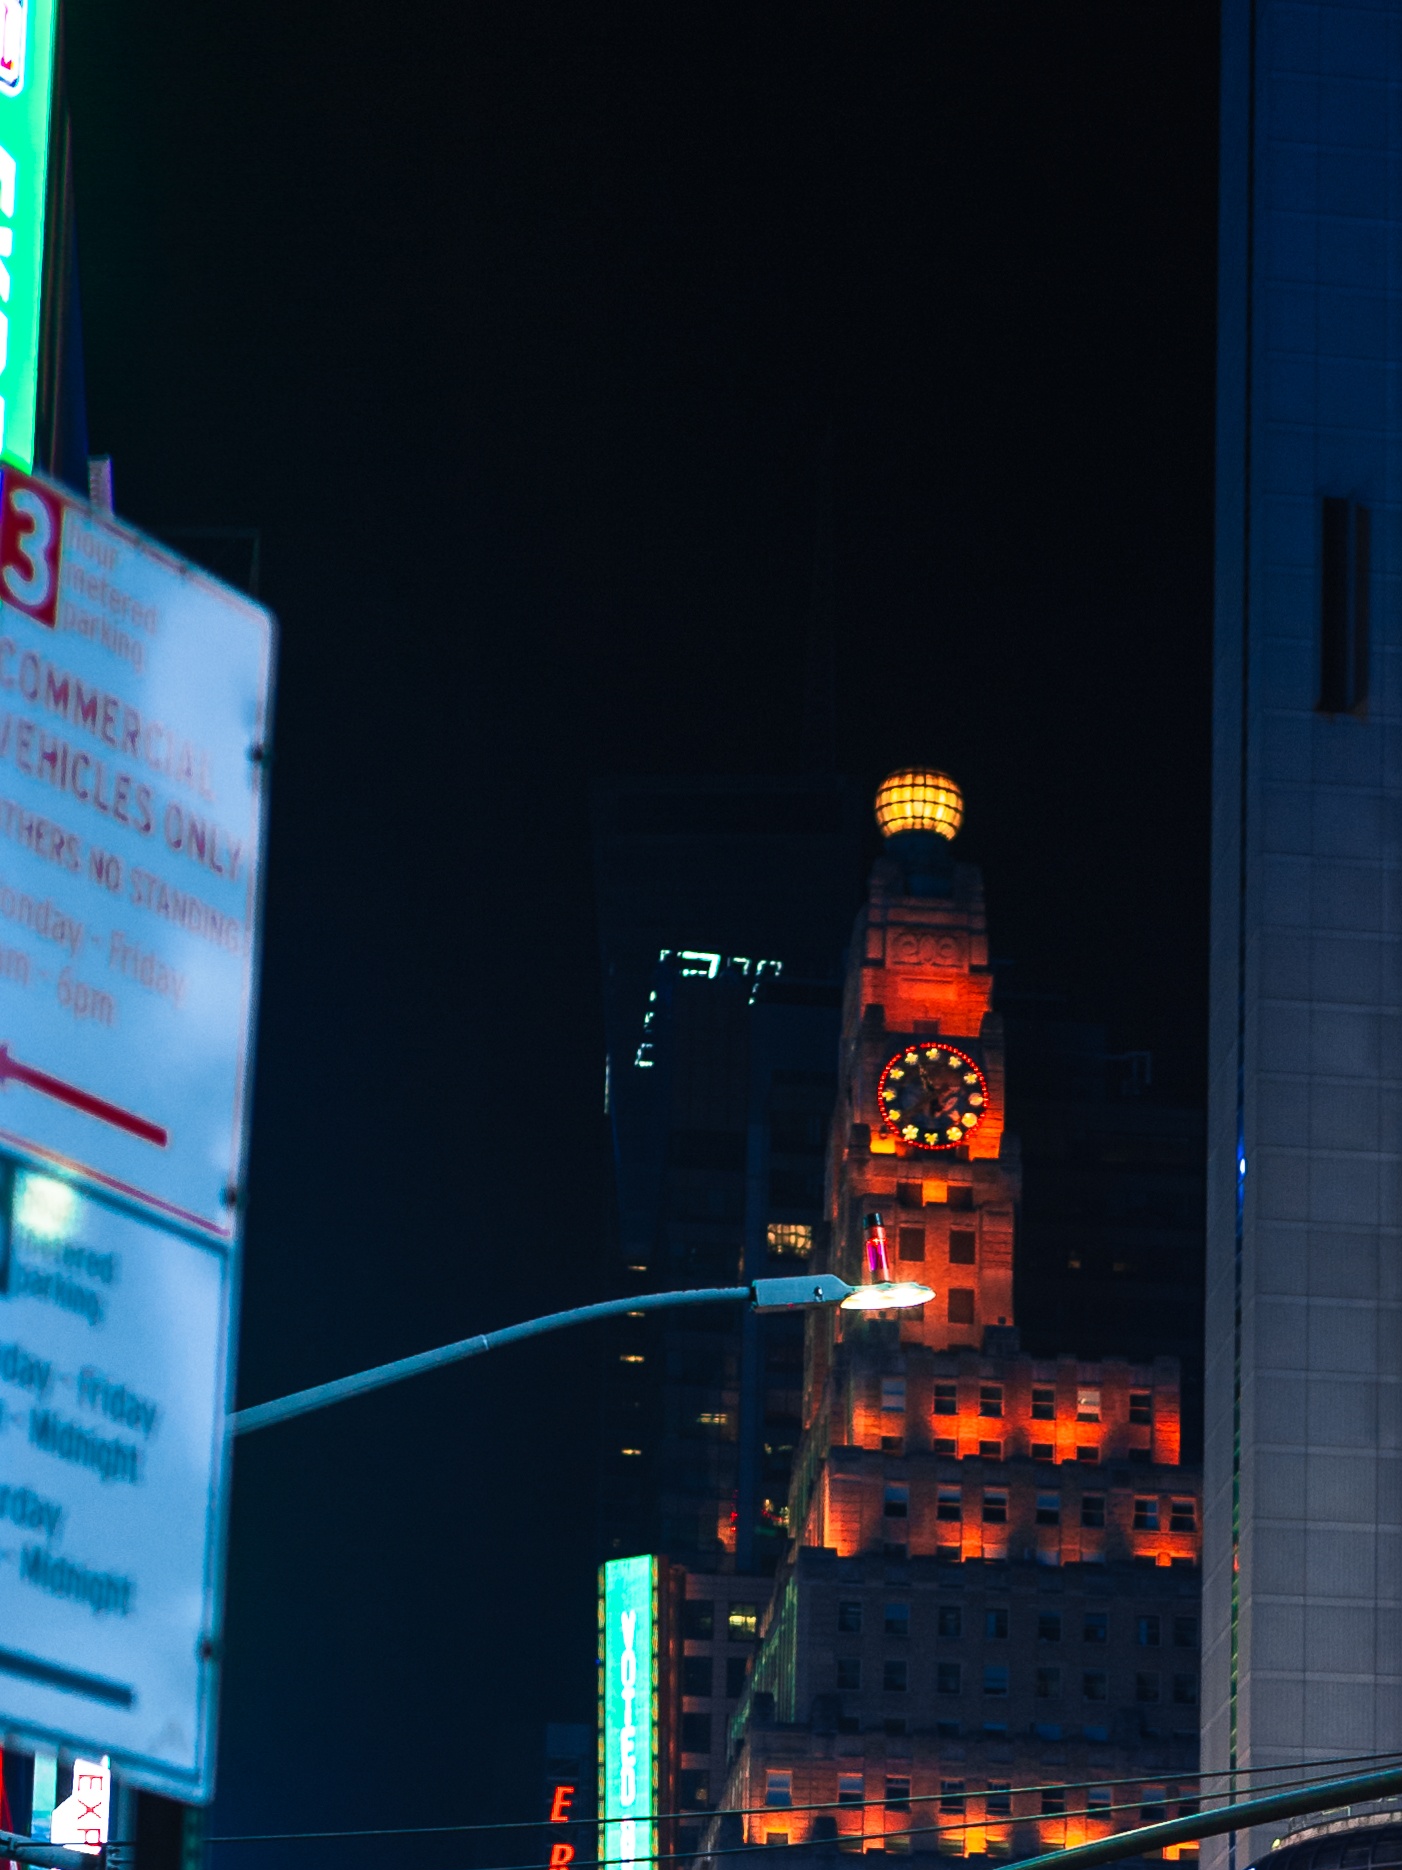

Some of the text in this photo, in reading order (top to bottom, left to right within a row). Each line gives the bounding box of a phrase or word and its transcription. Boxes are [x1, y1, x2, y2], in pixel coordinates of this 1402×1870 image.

[3, 488, 51, 606] 3
[163, 800, 242, 883] ONLY
[89, 846, 122, 895] NO
[130, 866, 244, 956] STANDING
